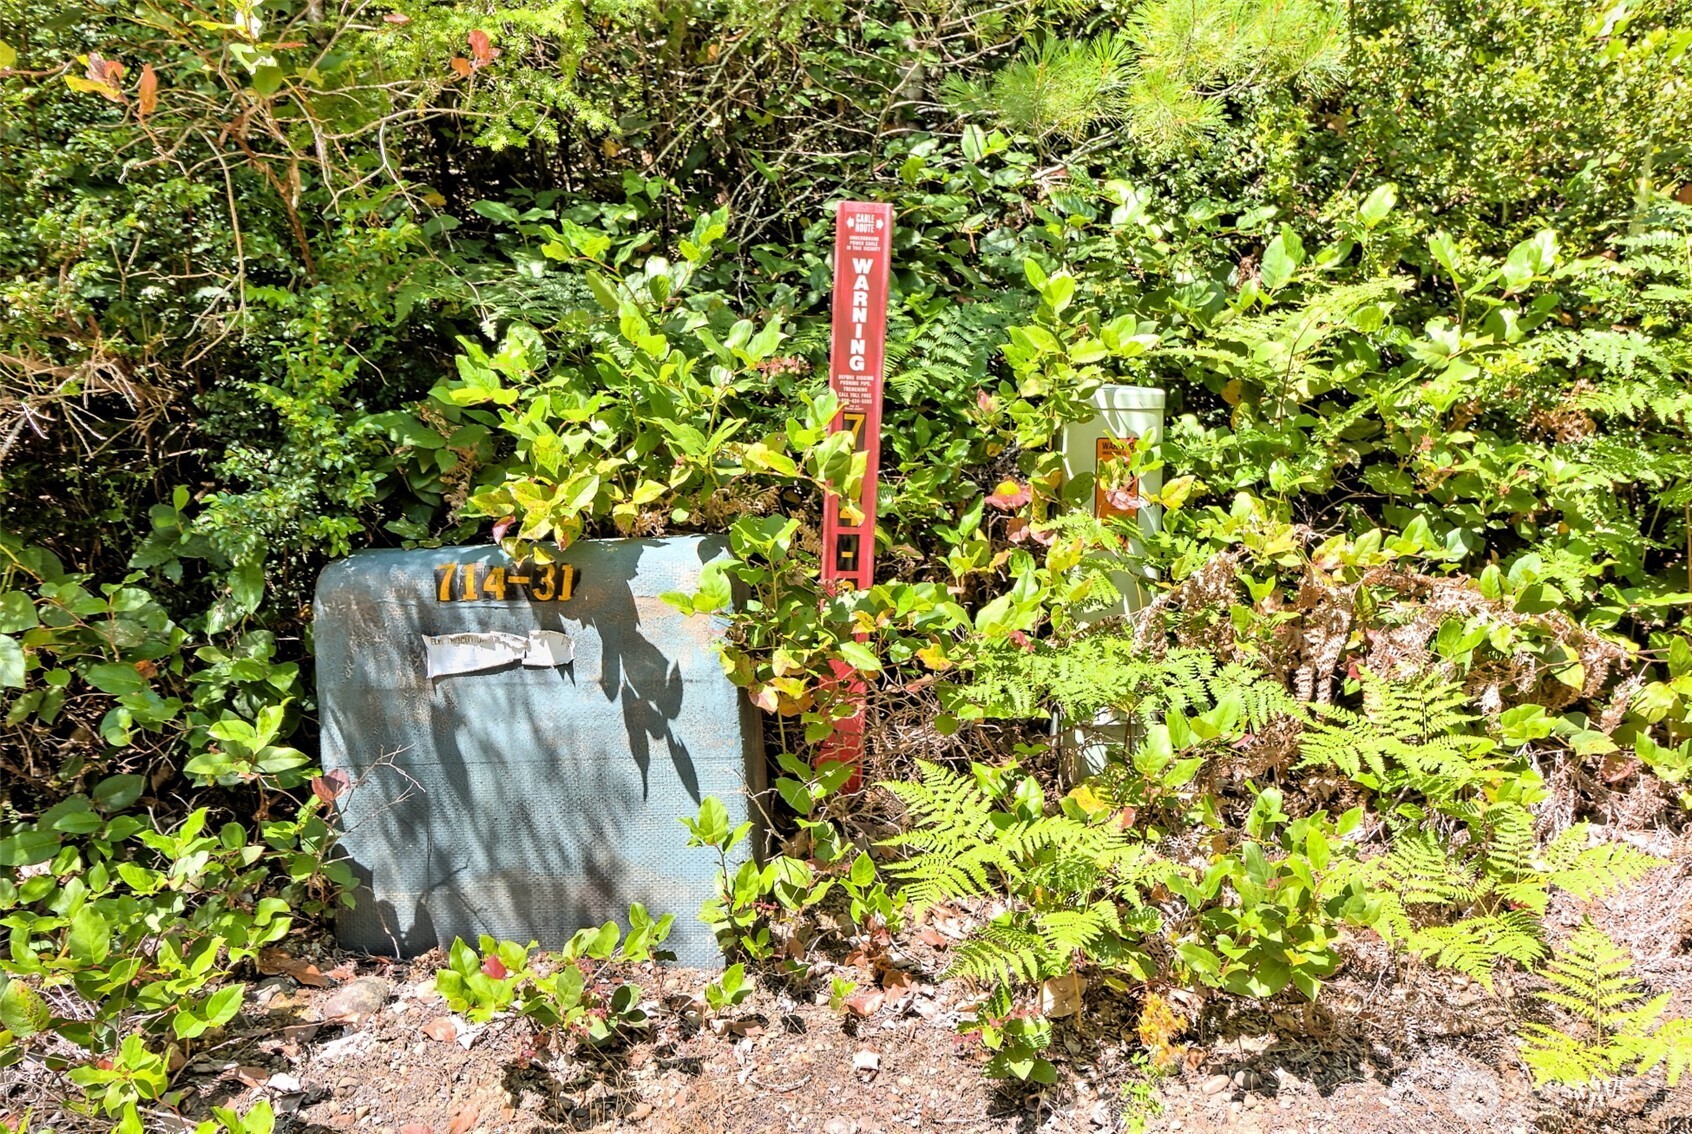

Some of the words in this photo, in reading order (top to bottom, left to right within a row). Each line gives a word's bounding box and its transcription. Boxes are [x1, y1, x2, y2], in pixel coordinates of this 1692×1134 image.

[855, 223, 875, 233] ROUTE
[849, 258, 873, 371] WARNING
[436, 562, 574, 601] 714-31
